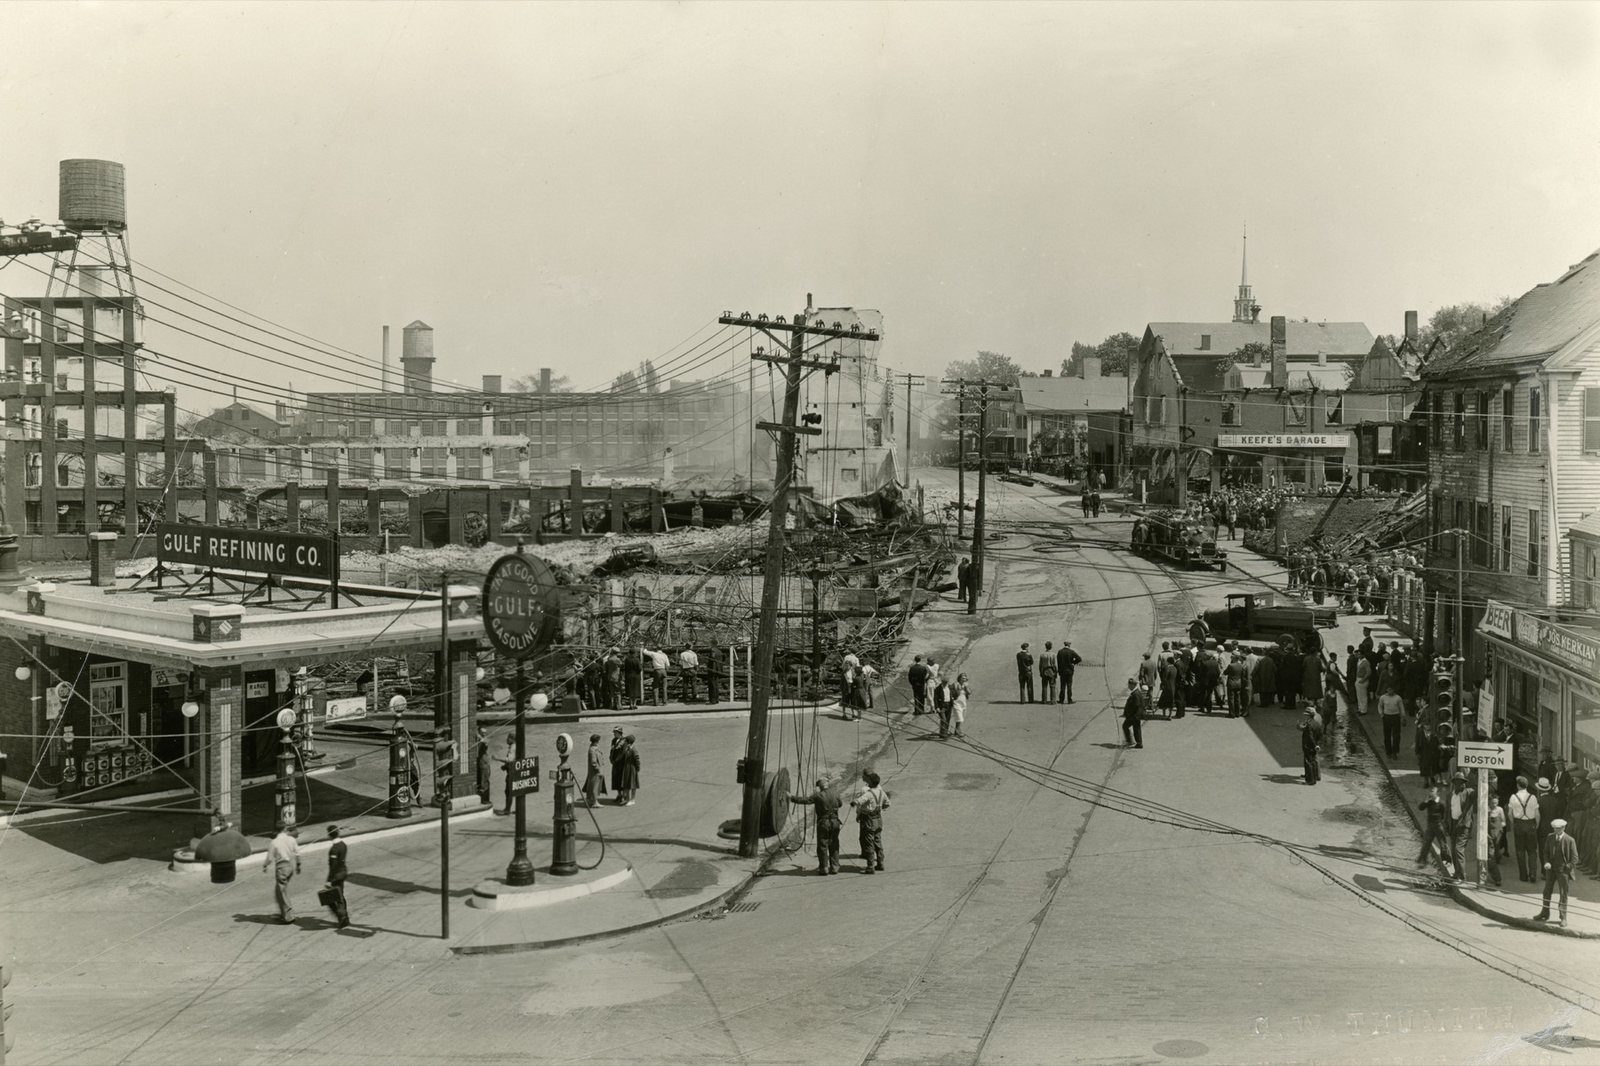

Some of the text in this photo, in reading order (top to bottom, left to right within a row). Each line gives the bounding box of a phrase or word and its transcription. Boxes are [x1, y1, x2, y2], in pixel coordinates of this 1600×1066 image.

[1241, 435, 1282, 444] KEEFE'S
[1286, 436, 1327, 445] GARAGE
[163, 533, 322, 567] GULF REFINING CO.
[491, 563, 538, 595] THAT GOOD
[495, 596, 536, 617] GULF
[1485, 606, 1510, 633] BEER
[492, 618, 538, 650] GASOLINE
[515, 758, 536, 770] OPEN
[1463, 755, 1505, 765] BOSTON
[512, 777, 538, 791] BUSINESS
